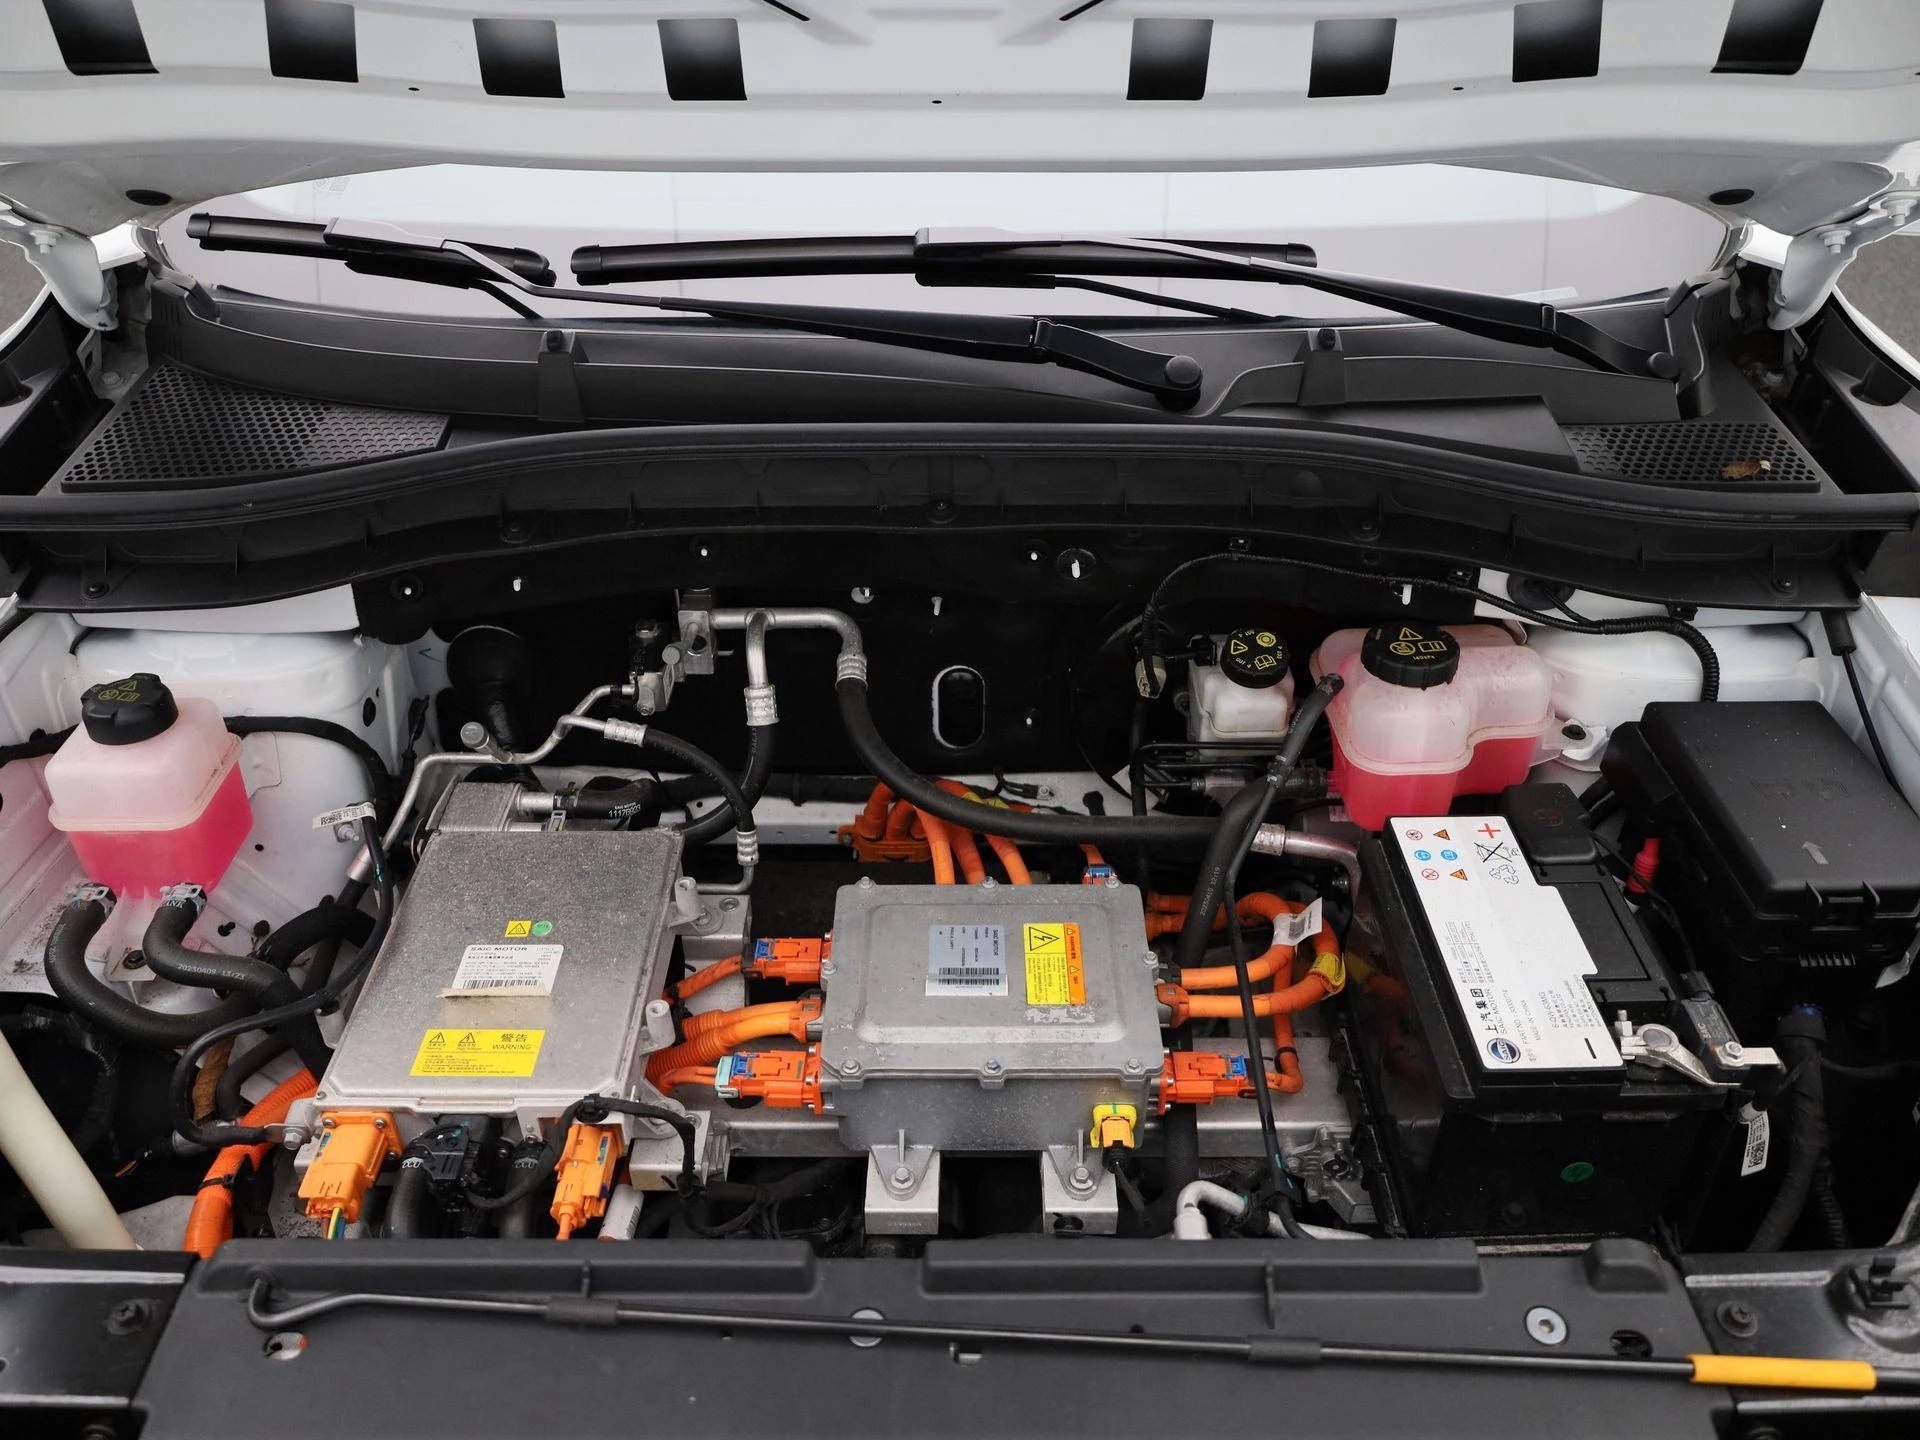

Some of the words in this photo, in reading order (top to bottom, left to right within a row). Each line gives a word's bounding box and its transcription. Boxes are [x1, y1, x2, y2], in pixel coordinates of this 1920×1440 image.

[1470, 988, 1498, 1034] 上汽集团
[1498, 1041, 1511, 1061] SAIC
